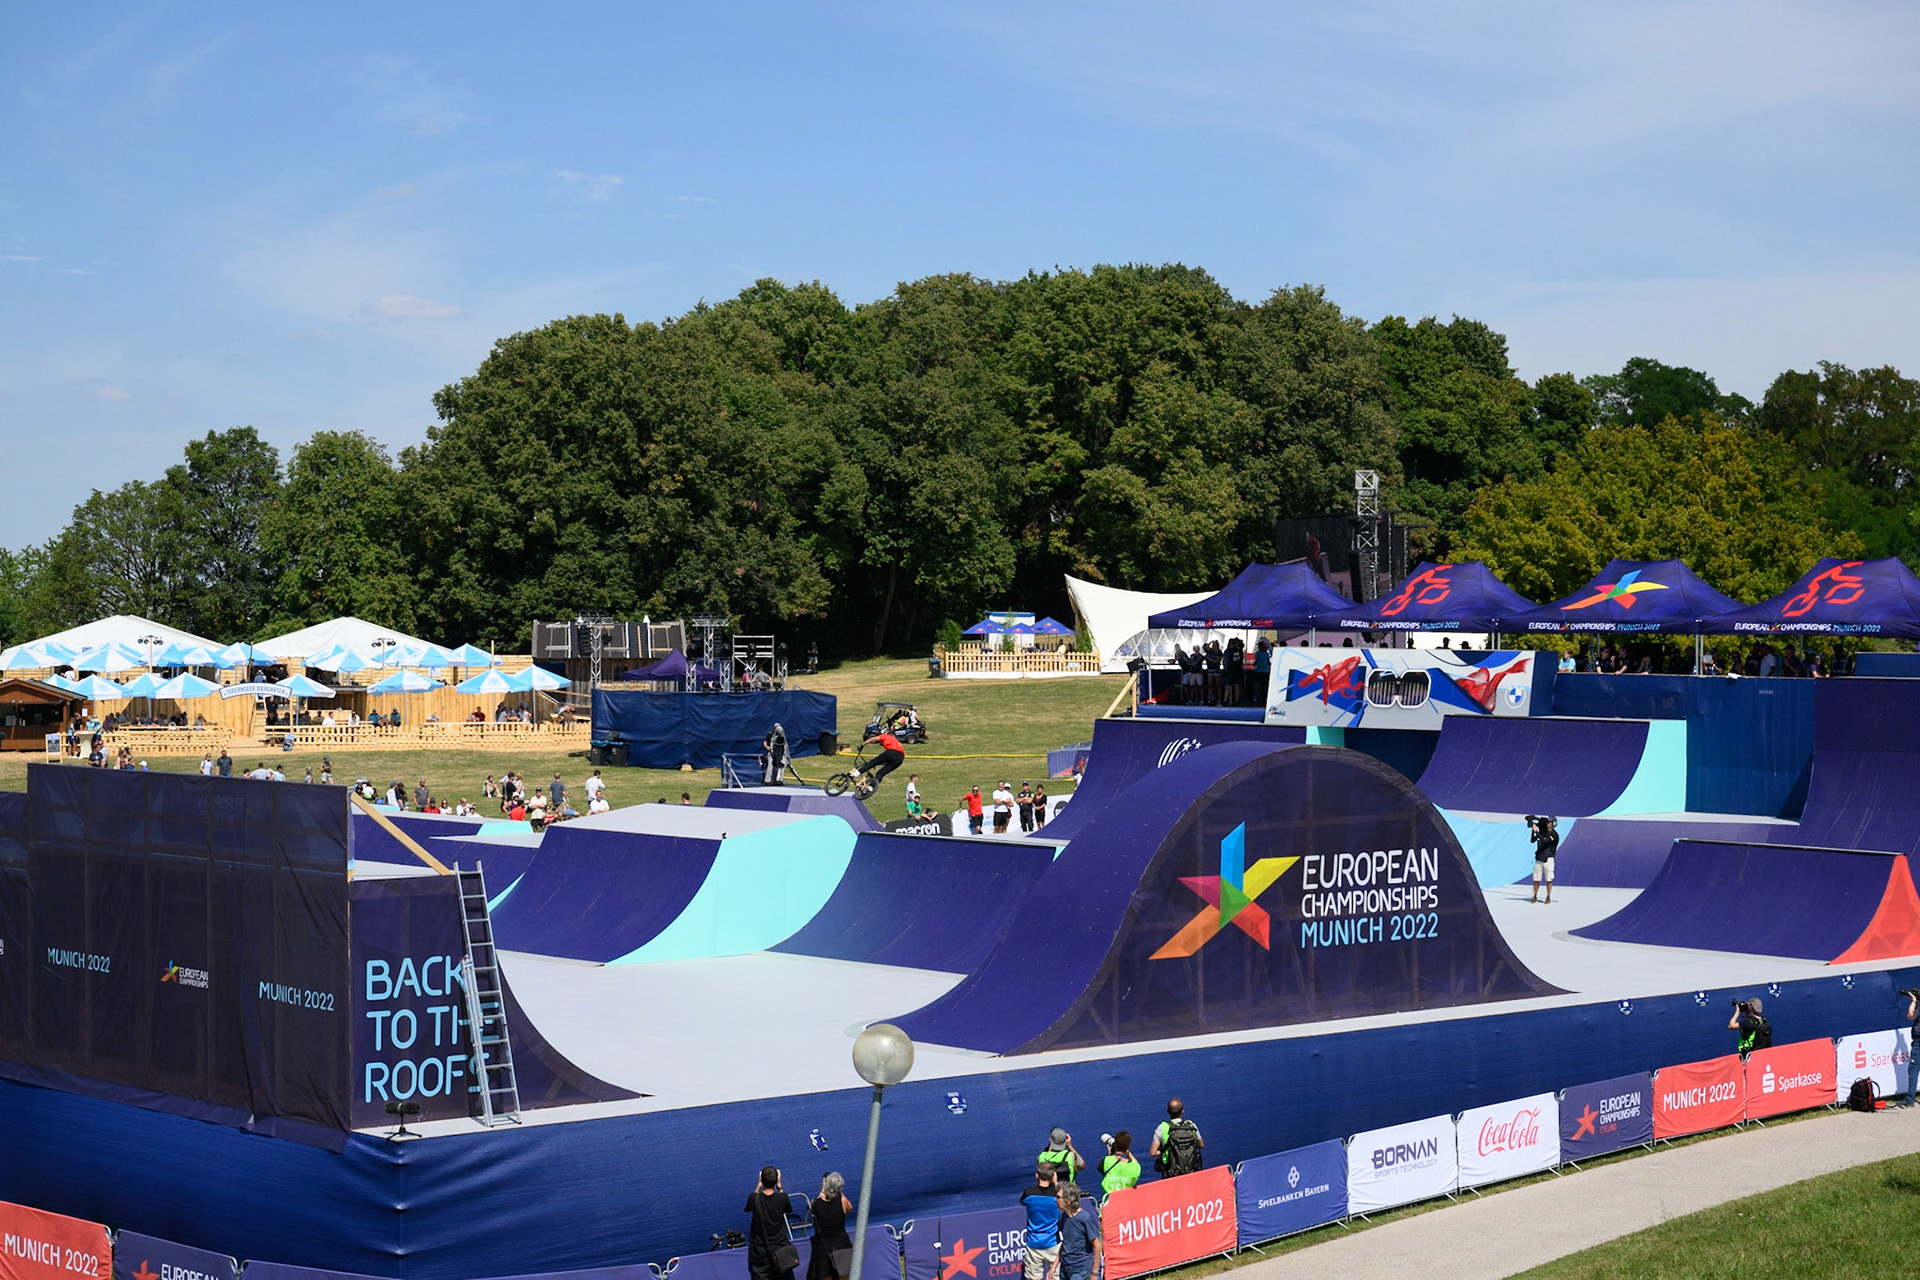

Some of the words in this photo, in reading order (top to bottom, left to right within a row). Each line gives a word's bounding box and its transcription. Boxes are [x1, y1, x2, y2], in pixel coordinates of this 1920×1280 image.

[1178, 619, 1205, 628] EUROPEAN
[1212, 620, 1252, 628] CHAMPIONSHIPS
[1340, 620, 1370, 628] EUROPEAN
[1378, 621, 1420, 629] CHAMPIONSHIPS
[1528, 622, 1560, 630] EUROPEAN
[1734, 622, 1770, 631] EUROPEAN
[1832, 624, 1862, 632] MUNICH
[1862, 624, 1881, 632] 2022
[1302, 848, 1438, 890] EUROPEAN
[1301, 885, 1438, 918] CHAMPIONSHIPS
[1302, 916, 1382, 948] MUNICH
[1390, 912, 1438, 941] 2022
[48, 947, 86, 968] MUNICH
[88, 954, 110, 973] 2022
[179, 966, 208, 981] EUROPEAN
[179, 978, 208, 988] CHAMPIONSHIPS
[366, 955, 468, 1002] BACK
[258, 981, 301, 1006] MUNICH
[304, 990, 334, 1012] 2022
[366, 1008, 418, 1052] TO
[1870, 1050, 1910, 1070] Sparkass
[1778, 1072, 1822, 1093] Sparkasse
[1600, 1092, 1641, 1114] EUROPEAN
[1663, 1086, 1706, 1112] MUNICH
[1709, 1081, 1736, 1103] 2022
[1600, 1106, 1641, 1125] CHAMPIONSHIPS
[1371, 1137, 1438, 1170] BORNAN
[1374, 1167, 1398, 1180] SPORTS
[1400, 1158, 1438, 1173] TECHNOLOGY
[1118, 1208, 1182, 1245] MUNICH
[1186, 1198, 1223, 1228] 2022
[988, 1228, 1028, 1251] EURO
[4, 1232, 60, 1267] MUNICH
[65, 1248, 98, 1278] 2022
